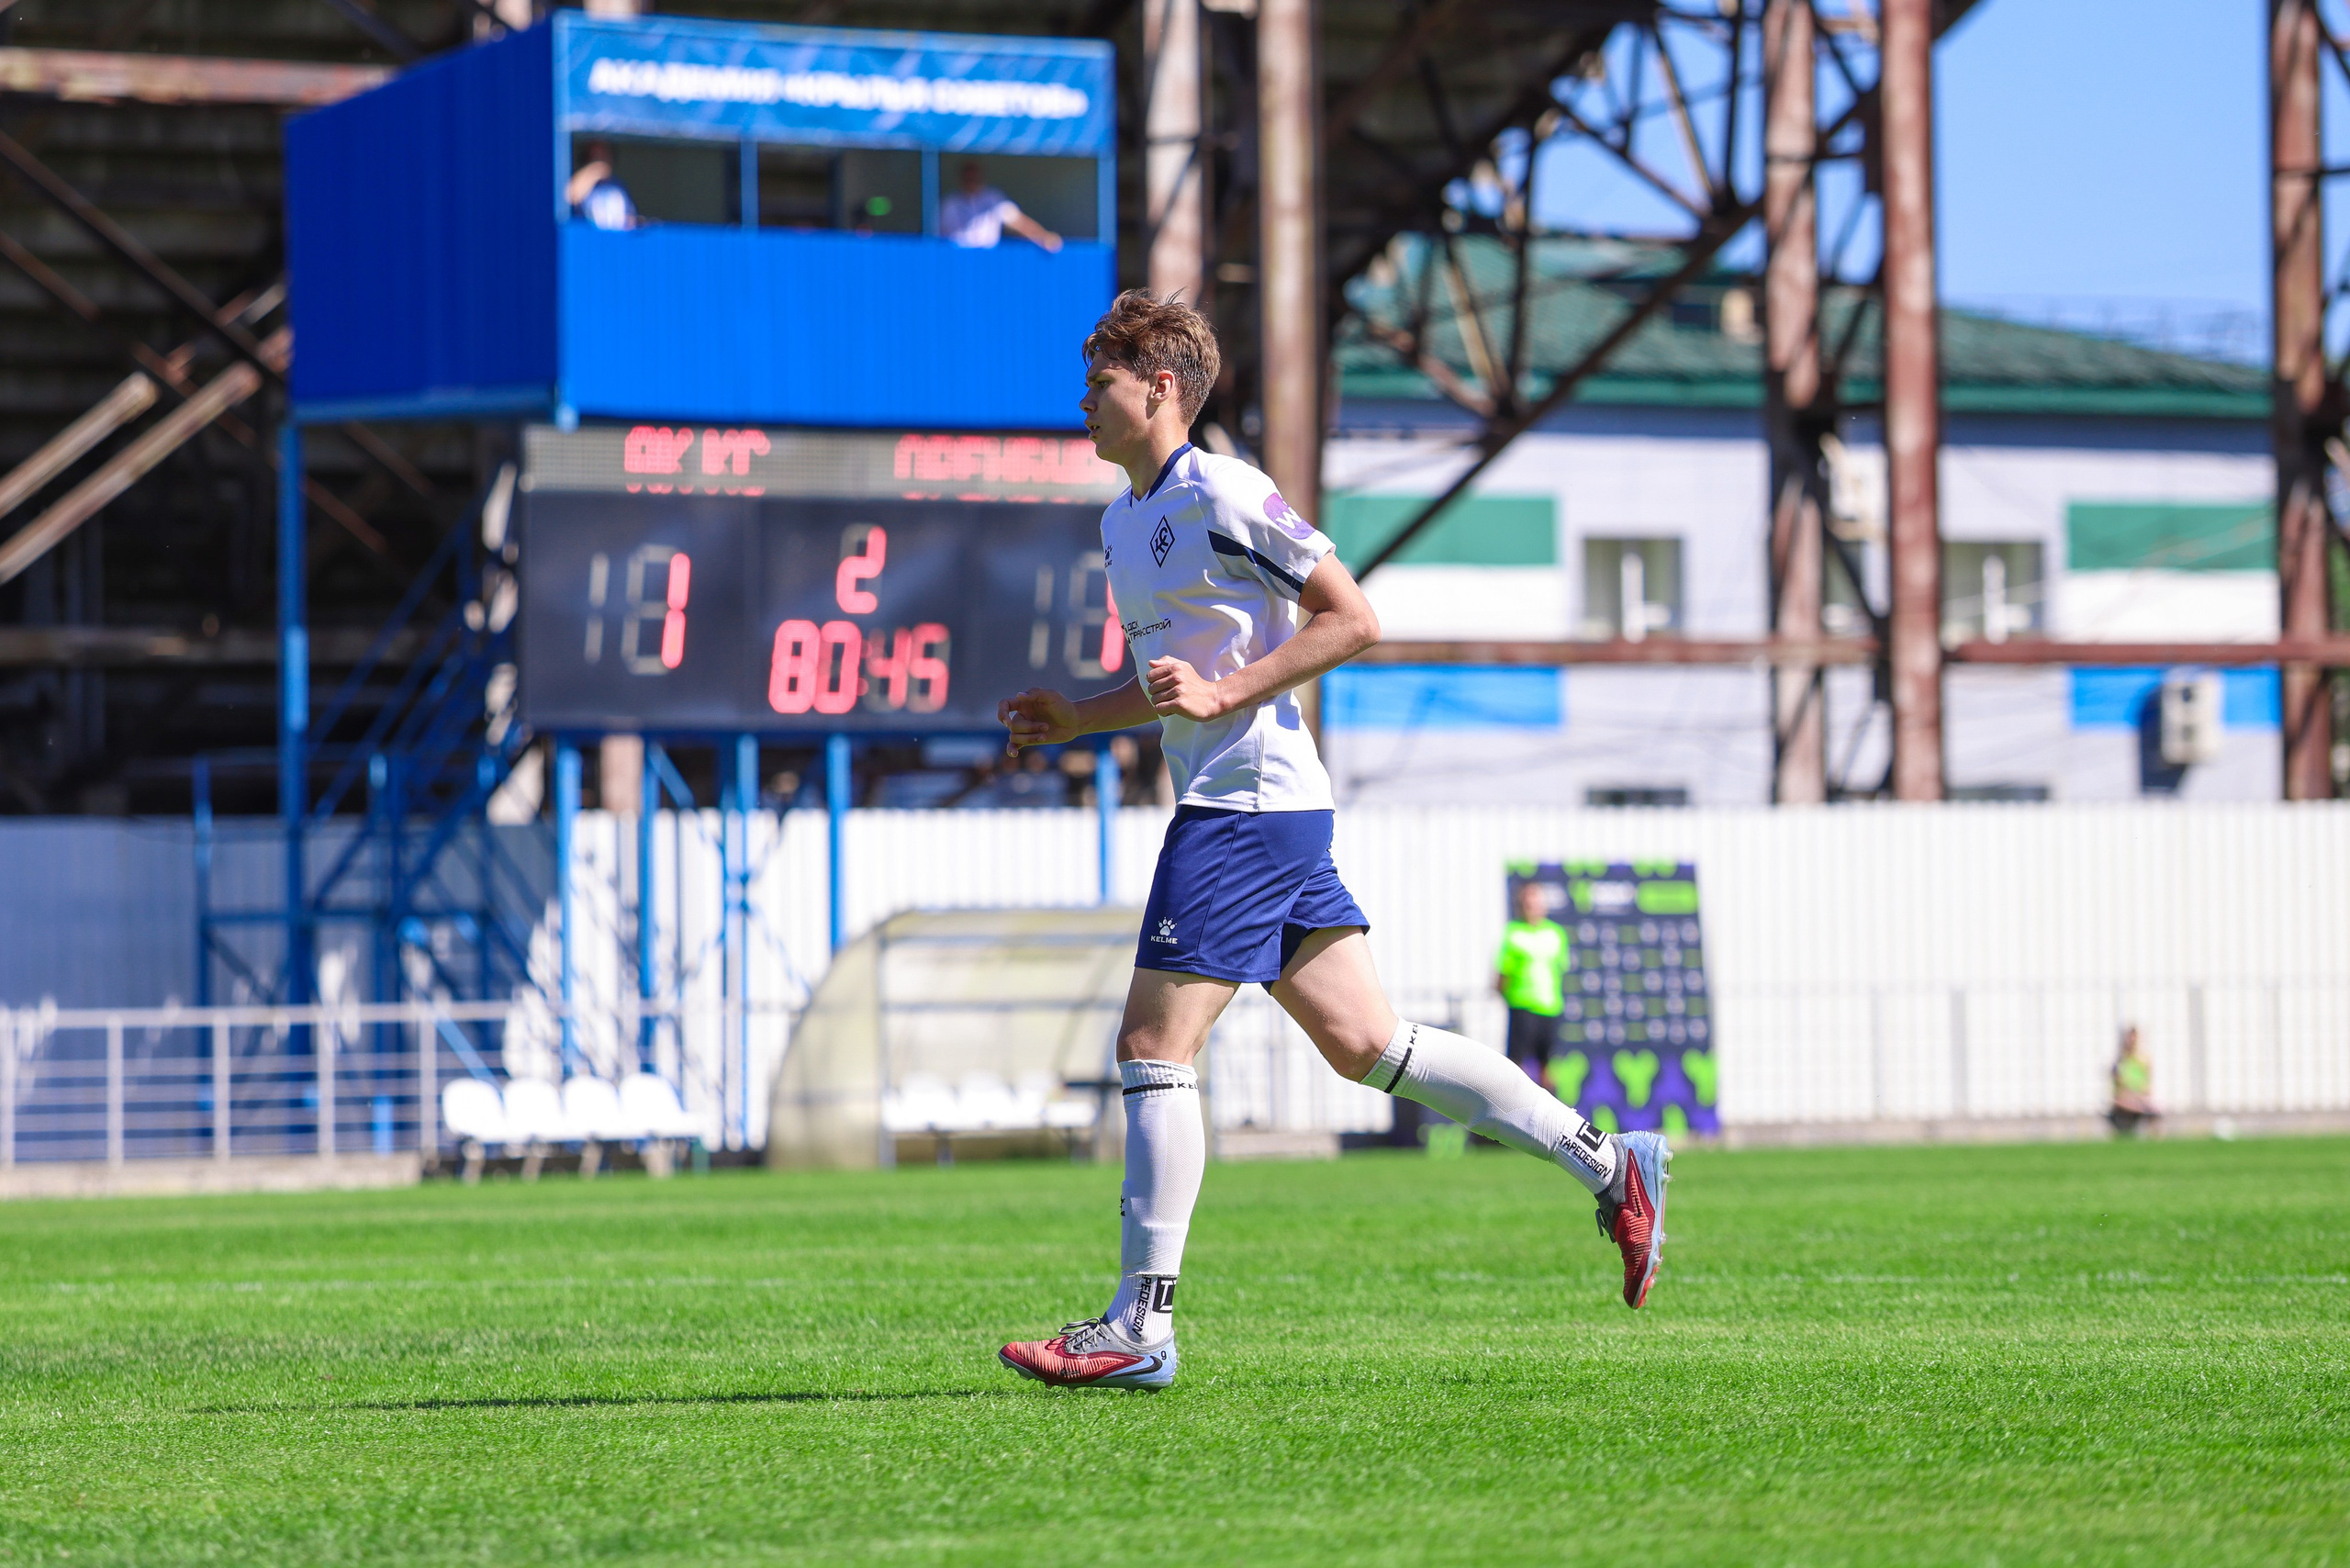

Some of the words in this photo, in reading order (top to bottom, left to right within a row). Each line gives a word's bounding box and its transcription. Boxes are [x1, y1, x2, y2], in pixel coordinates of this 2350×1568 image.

[836, 525, 886, 614] 2
[661, 552, 691, 669] 1
[1150, 935, 1179, 945] KELME
[1559, 1134, 1612, 1180] TAPEDESIGN
[1132, 1273, 1152, 1338] PEDESIGN
